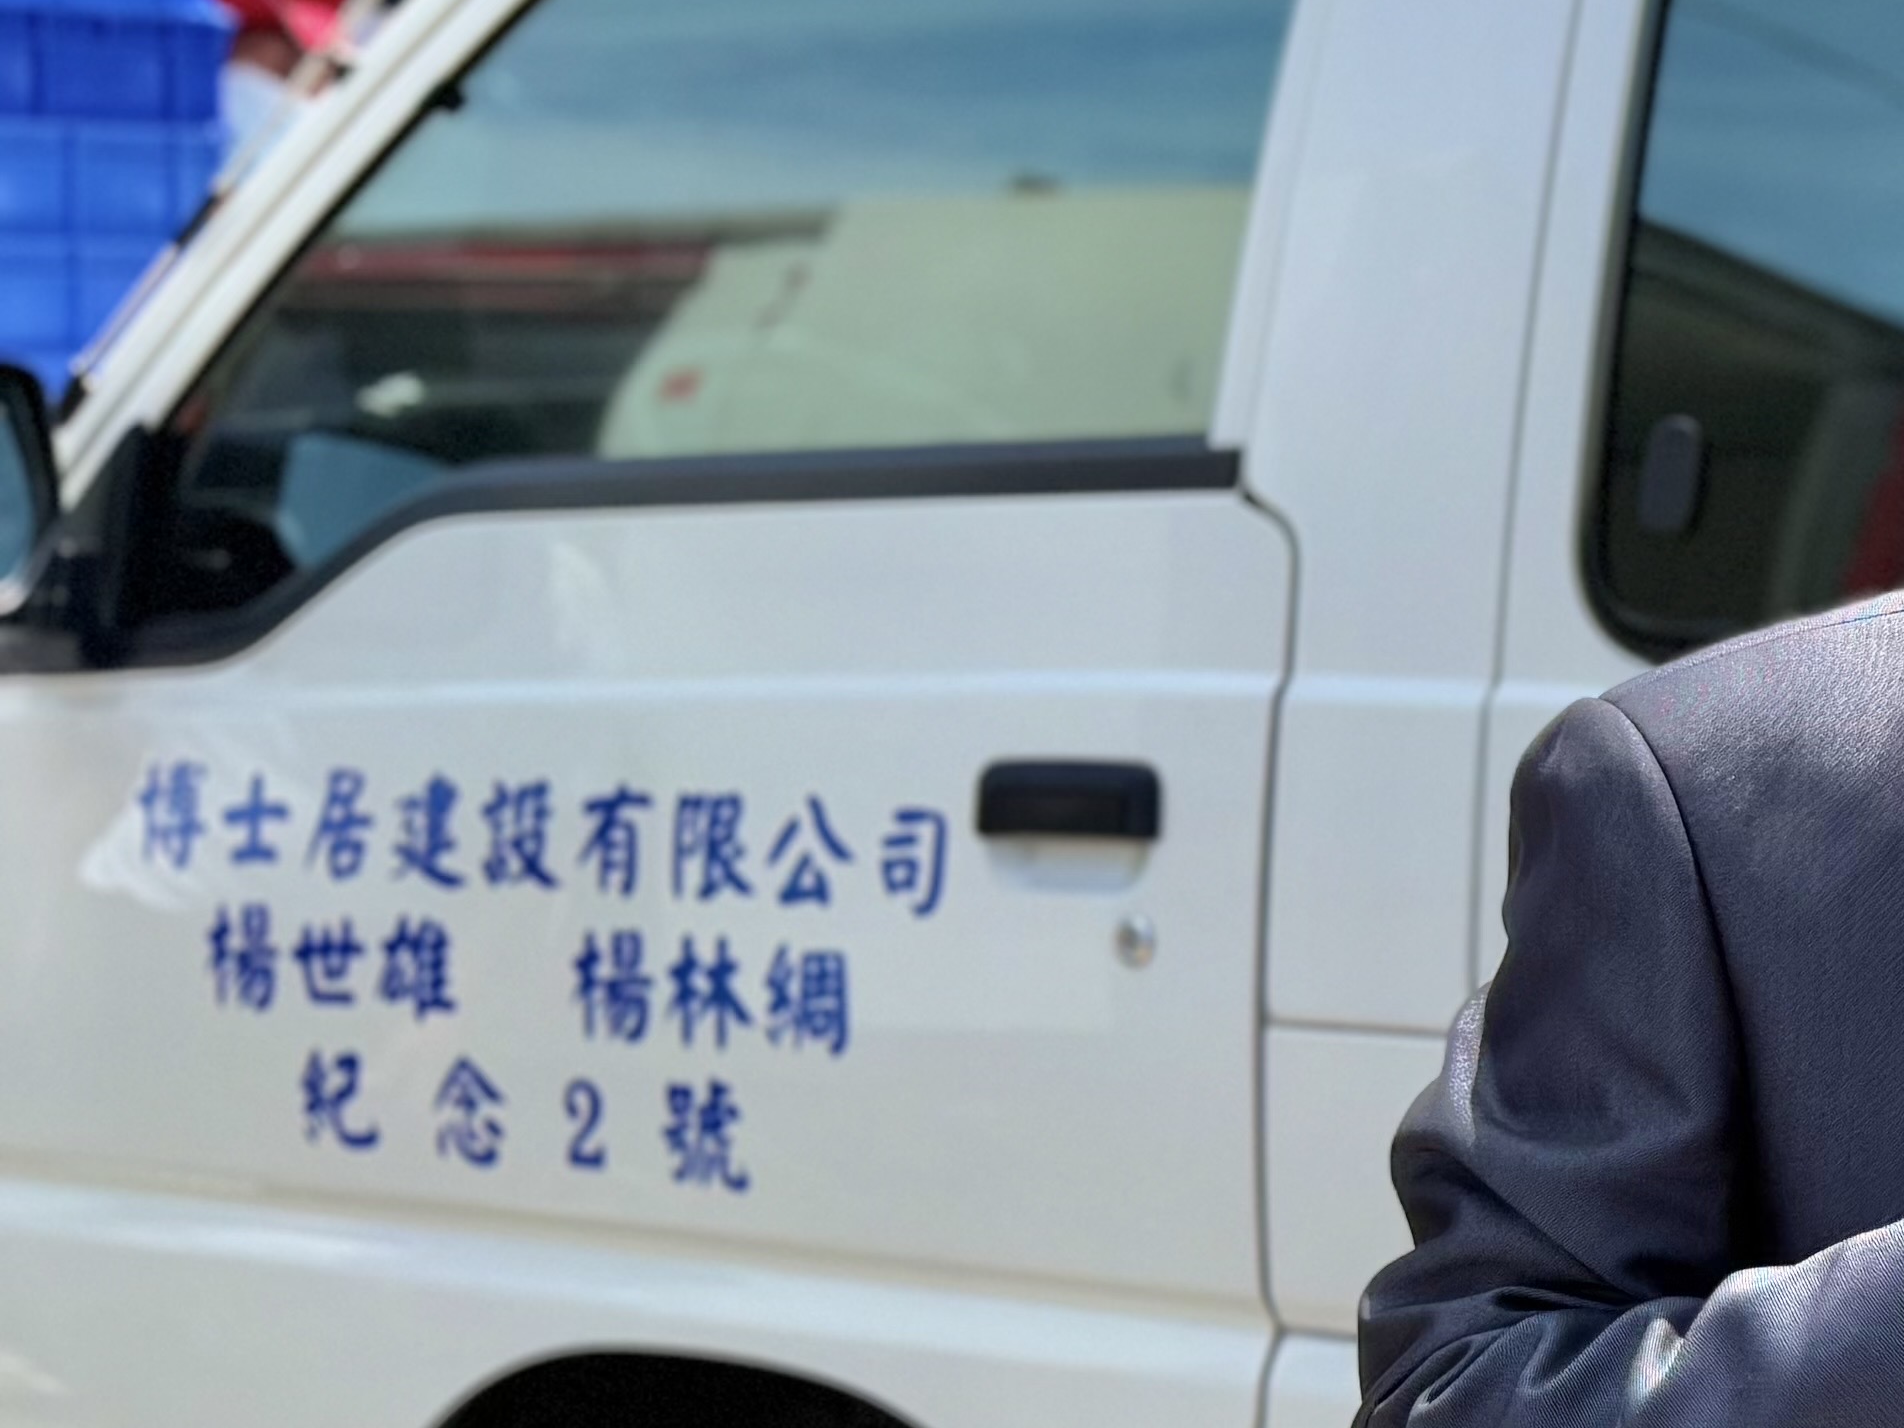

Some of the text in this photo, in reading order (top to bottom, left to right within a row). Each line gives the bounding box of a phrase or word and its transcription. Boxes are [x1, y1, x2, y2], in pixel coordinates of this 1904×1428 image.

[138, 760, 947, 918] 博士居建設有限公司
[207, 903, 457, 1024] 楊世雄
